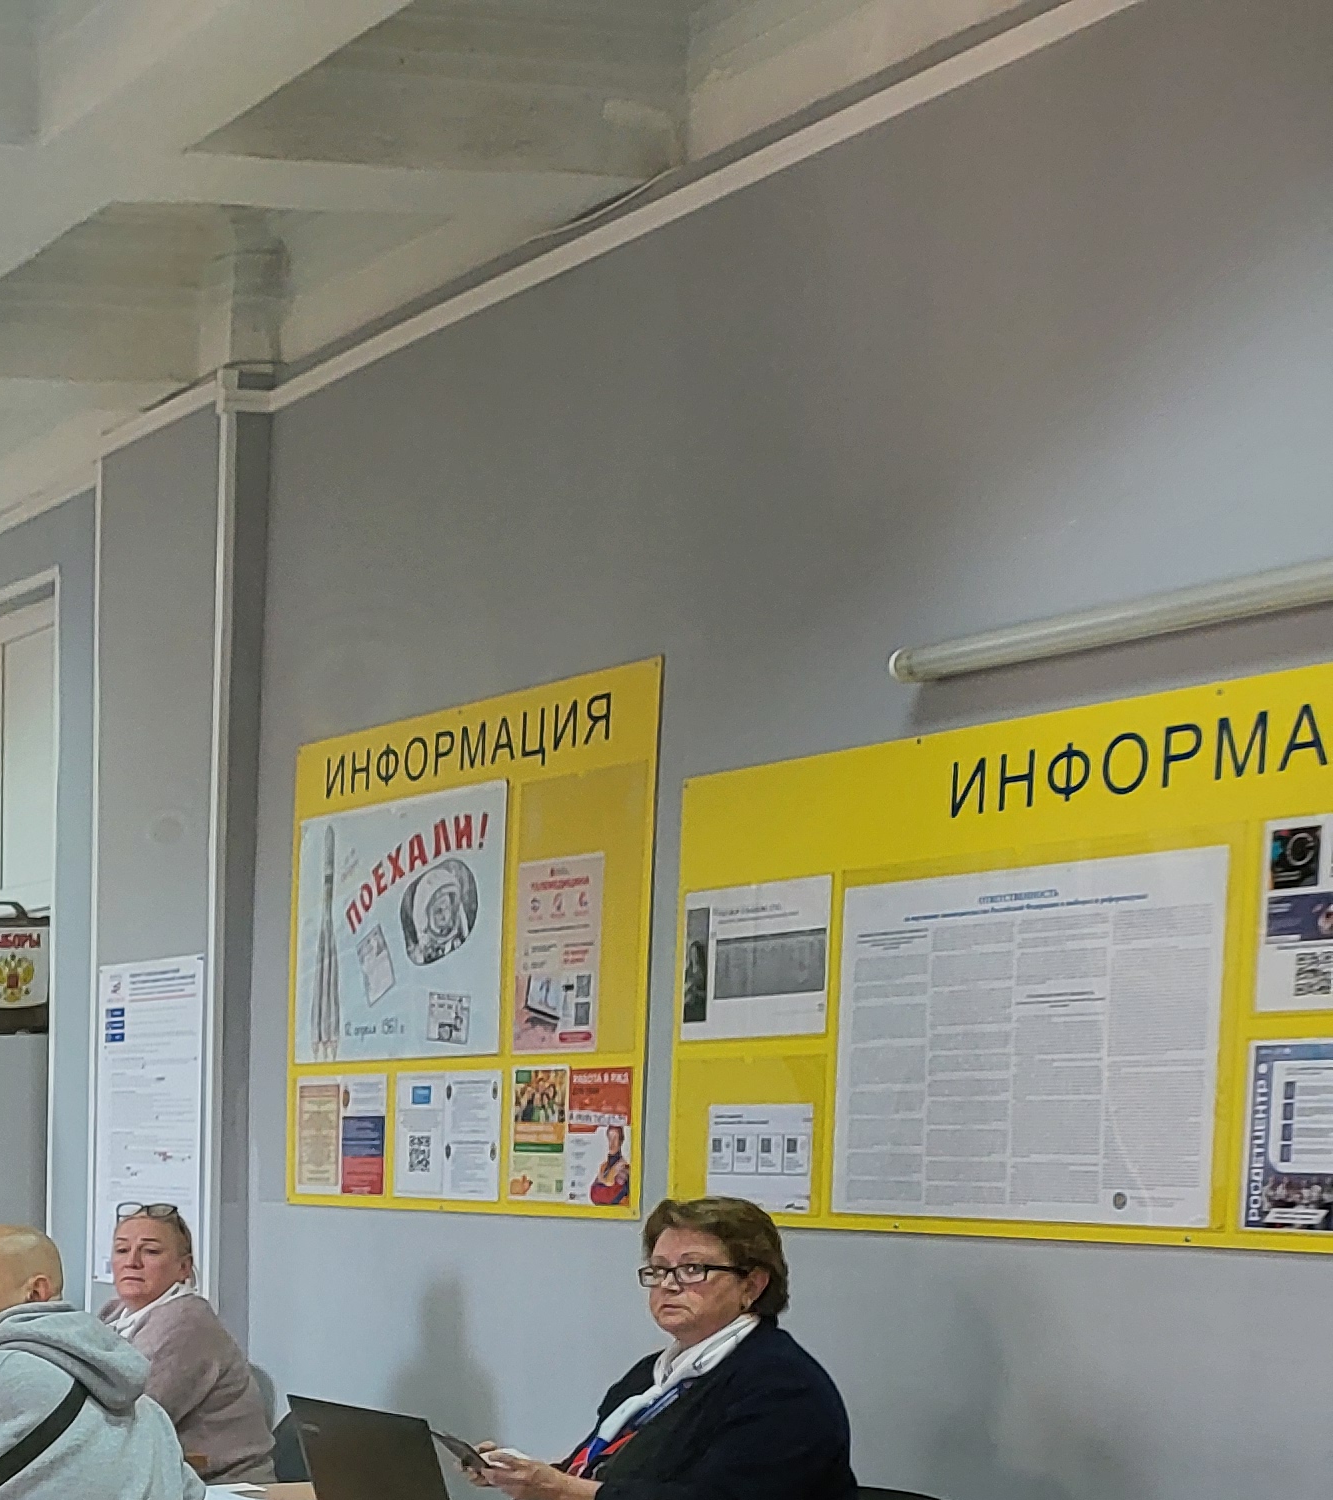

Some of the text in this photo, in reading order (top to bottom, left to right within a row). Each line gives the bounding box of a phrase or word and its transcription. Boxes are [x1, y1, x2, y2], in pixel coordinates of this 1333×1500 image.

[325, 691, 612, 800] ИНФОРМАЦИЯ
[949, 703, 1328, 819] ИНФОРМА
[344, 812, 489, 935] ПОЕХАЛИ!
